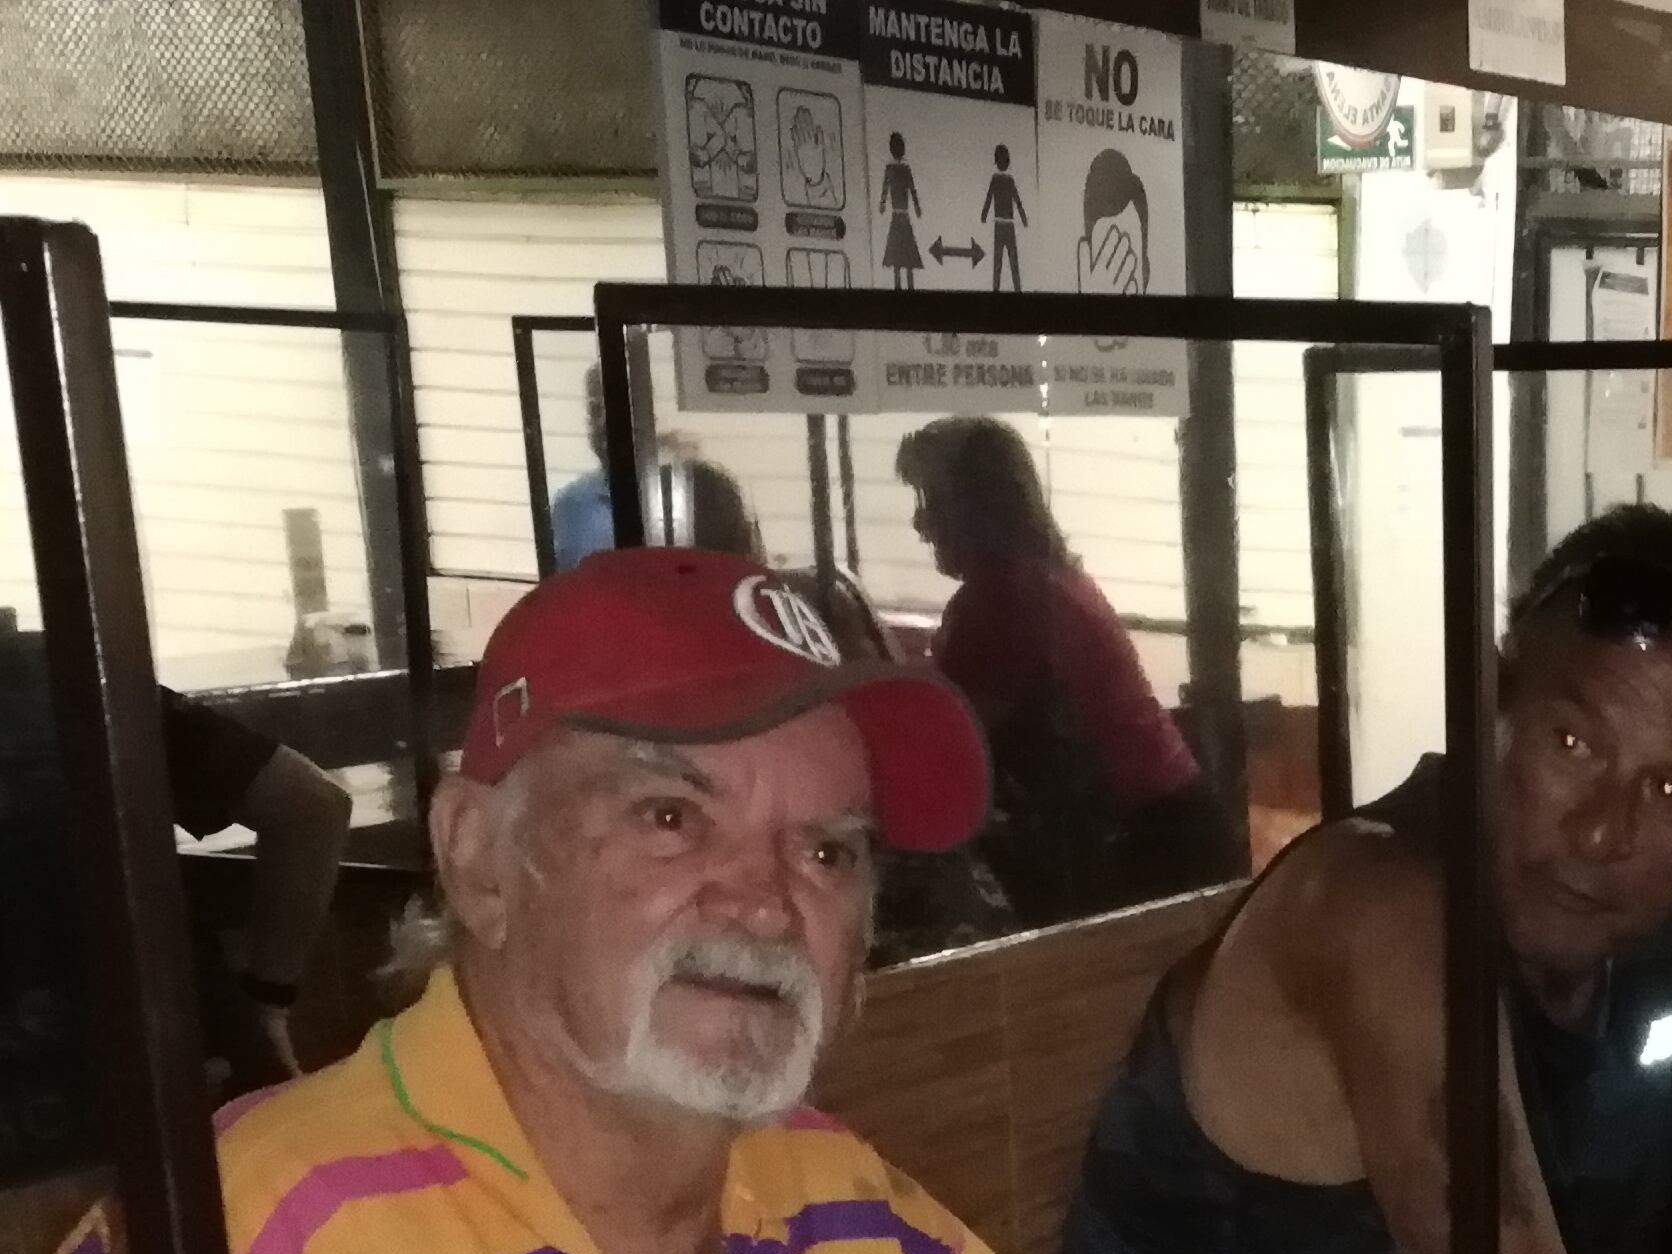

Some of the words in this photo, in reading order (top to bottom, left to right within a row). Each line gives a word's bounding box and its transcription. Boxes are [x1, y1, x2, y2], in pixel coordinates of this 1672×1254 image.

[699, 1, 822, 48] CONTACTO
[869, 7, 994, 57] MANTENGA
[996, 26, 1023, 59] LA
[890, 48, 1006, 94] DISTANCIA
[1083, 43, 1139, 106] NO
[1067, 102, 1115, 129] TOQUE
[1118, 111, 1135, 133] LA
[1139, 116, 1176, 141] CARA
[886, 363, 947, 387] ENTRE
